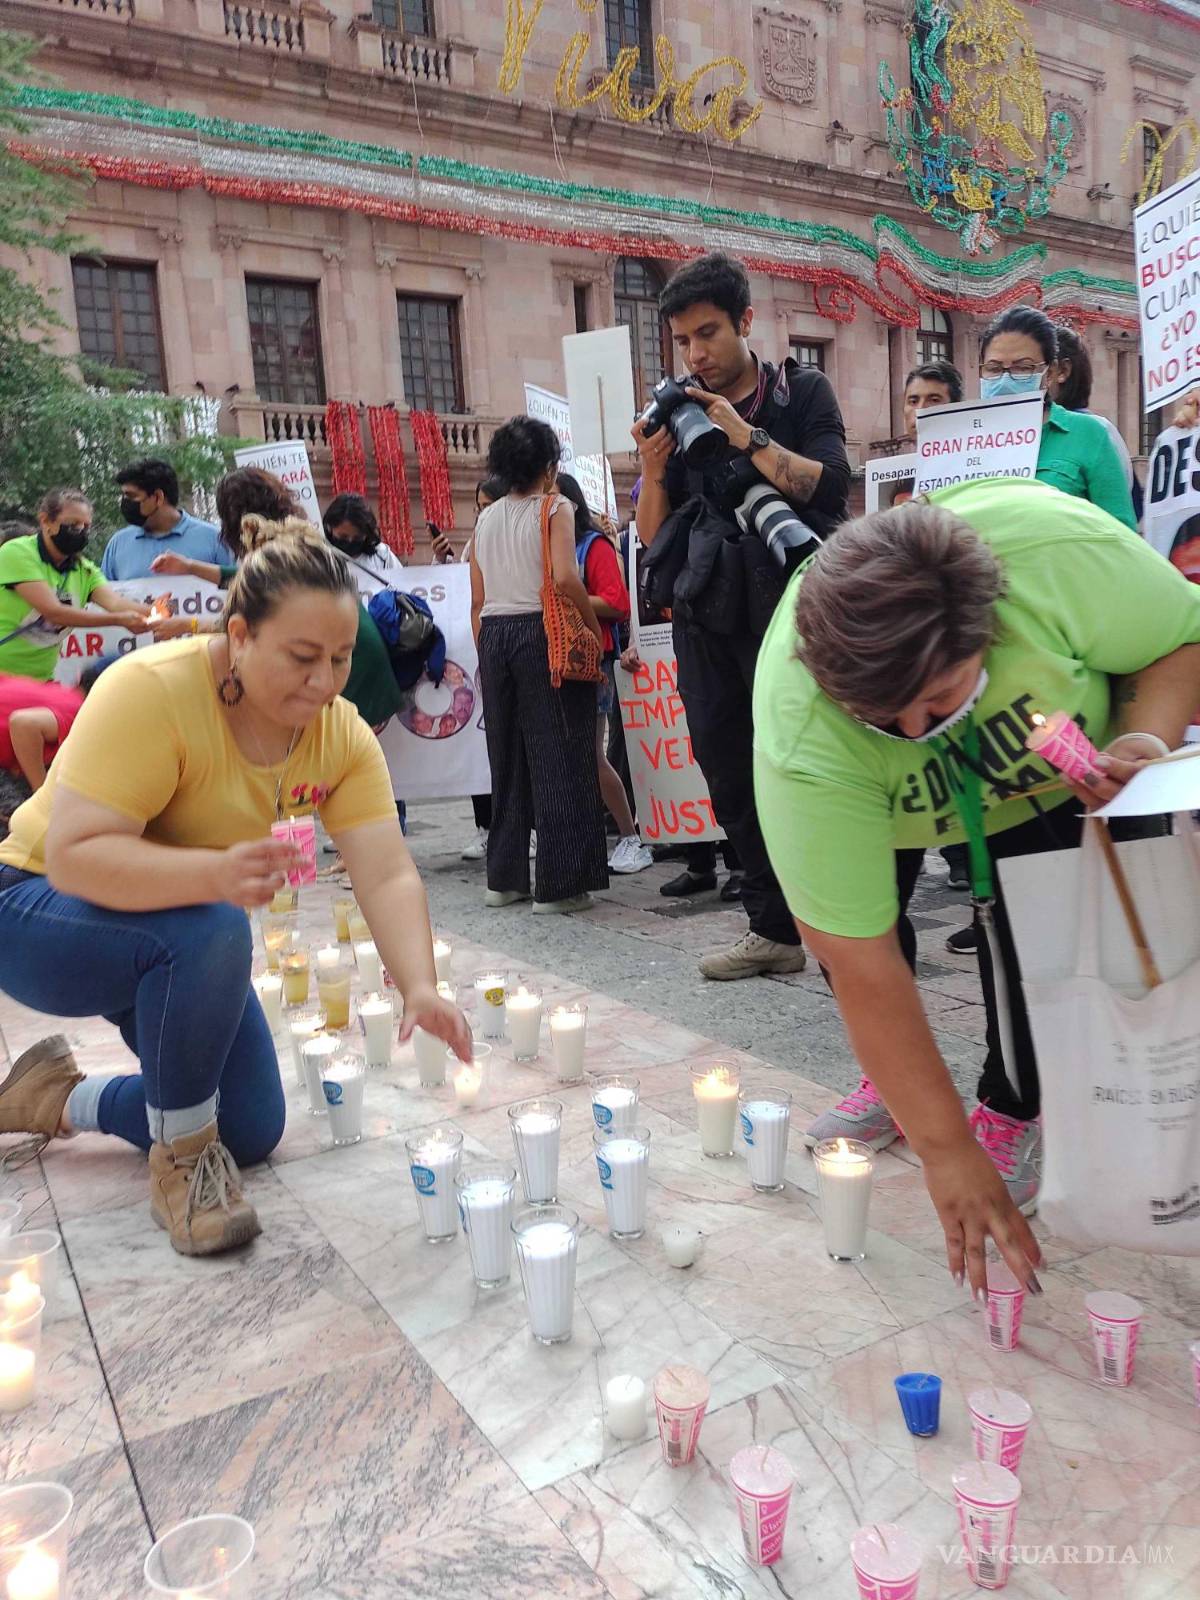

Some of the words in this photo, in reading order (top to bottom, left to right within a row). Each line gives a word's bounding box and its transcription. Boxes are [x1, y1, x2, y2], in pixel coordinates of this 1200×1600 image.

[1148, 358, 1180, 392] NO
[973, 418, 984, 429] EL
[921, 438, 962, 457] GRAN
[966, 428, 1037, 451] FRACASO
[966, 457, 982, 468] DEL
